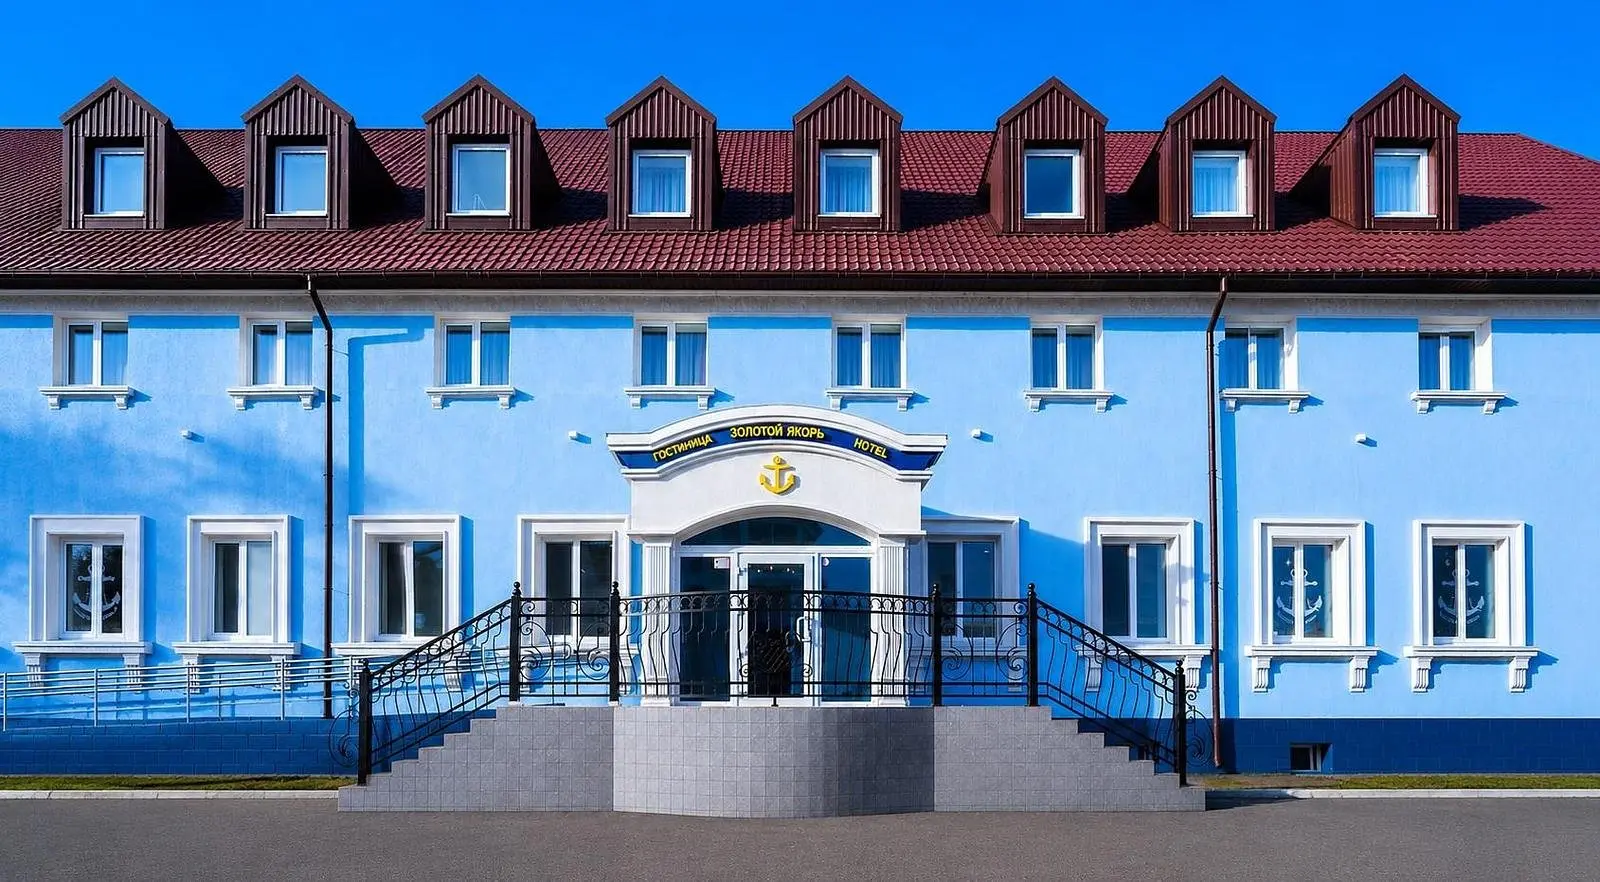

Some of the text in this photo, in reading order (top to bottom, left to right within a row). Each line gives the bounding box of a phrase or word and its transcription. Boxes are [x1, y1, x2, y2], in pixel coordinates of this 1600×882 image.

[653, 423, 888, 461] ГОСТИНИЦА ЗОЛОТОЙ ЯКОРЬ HOTEL
